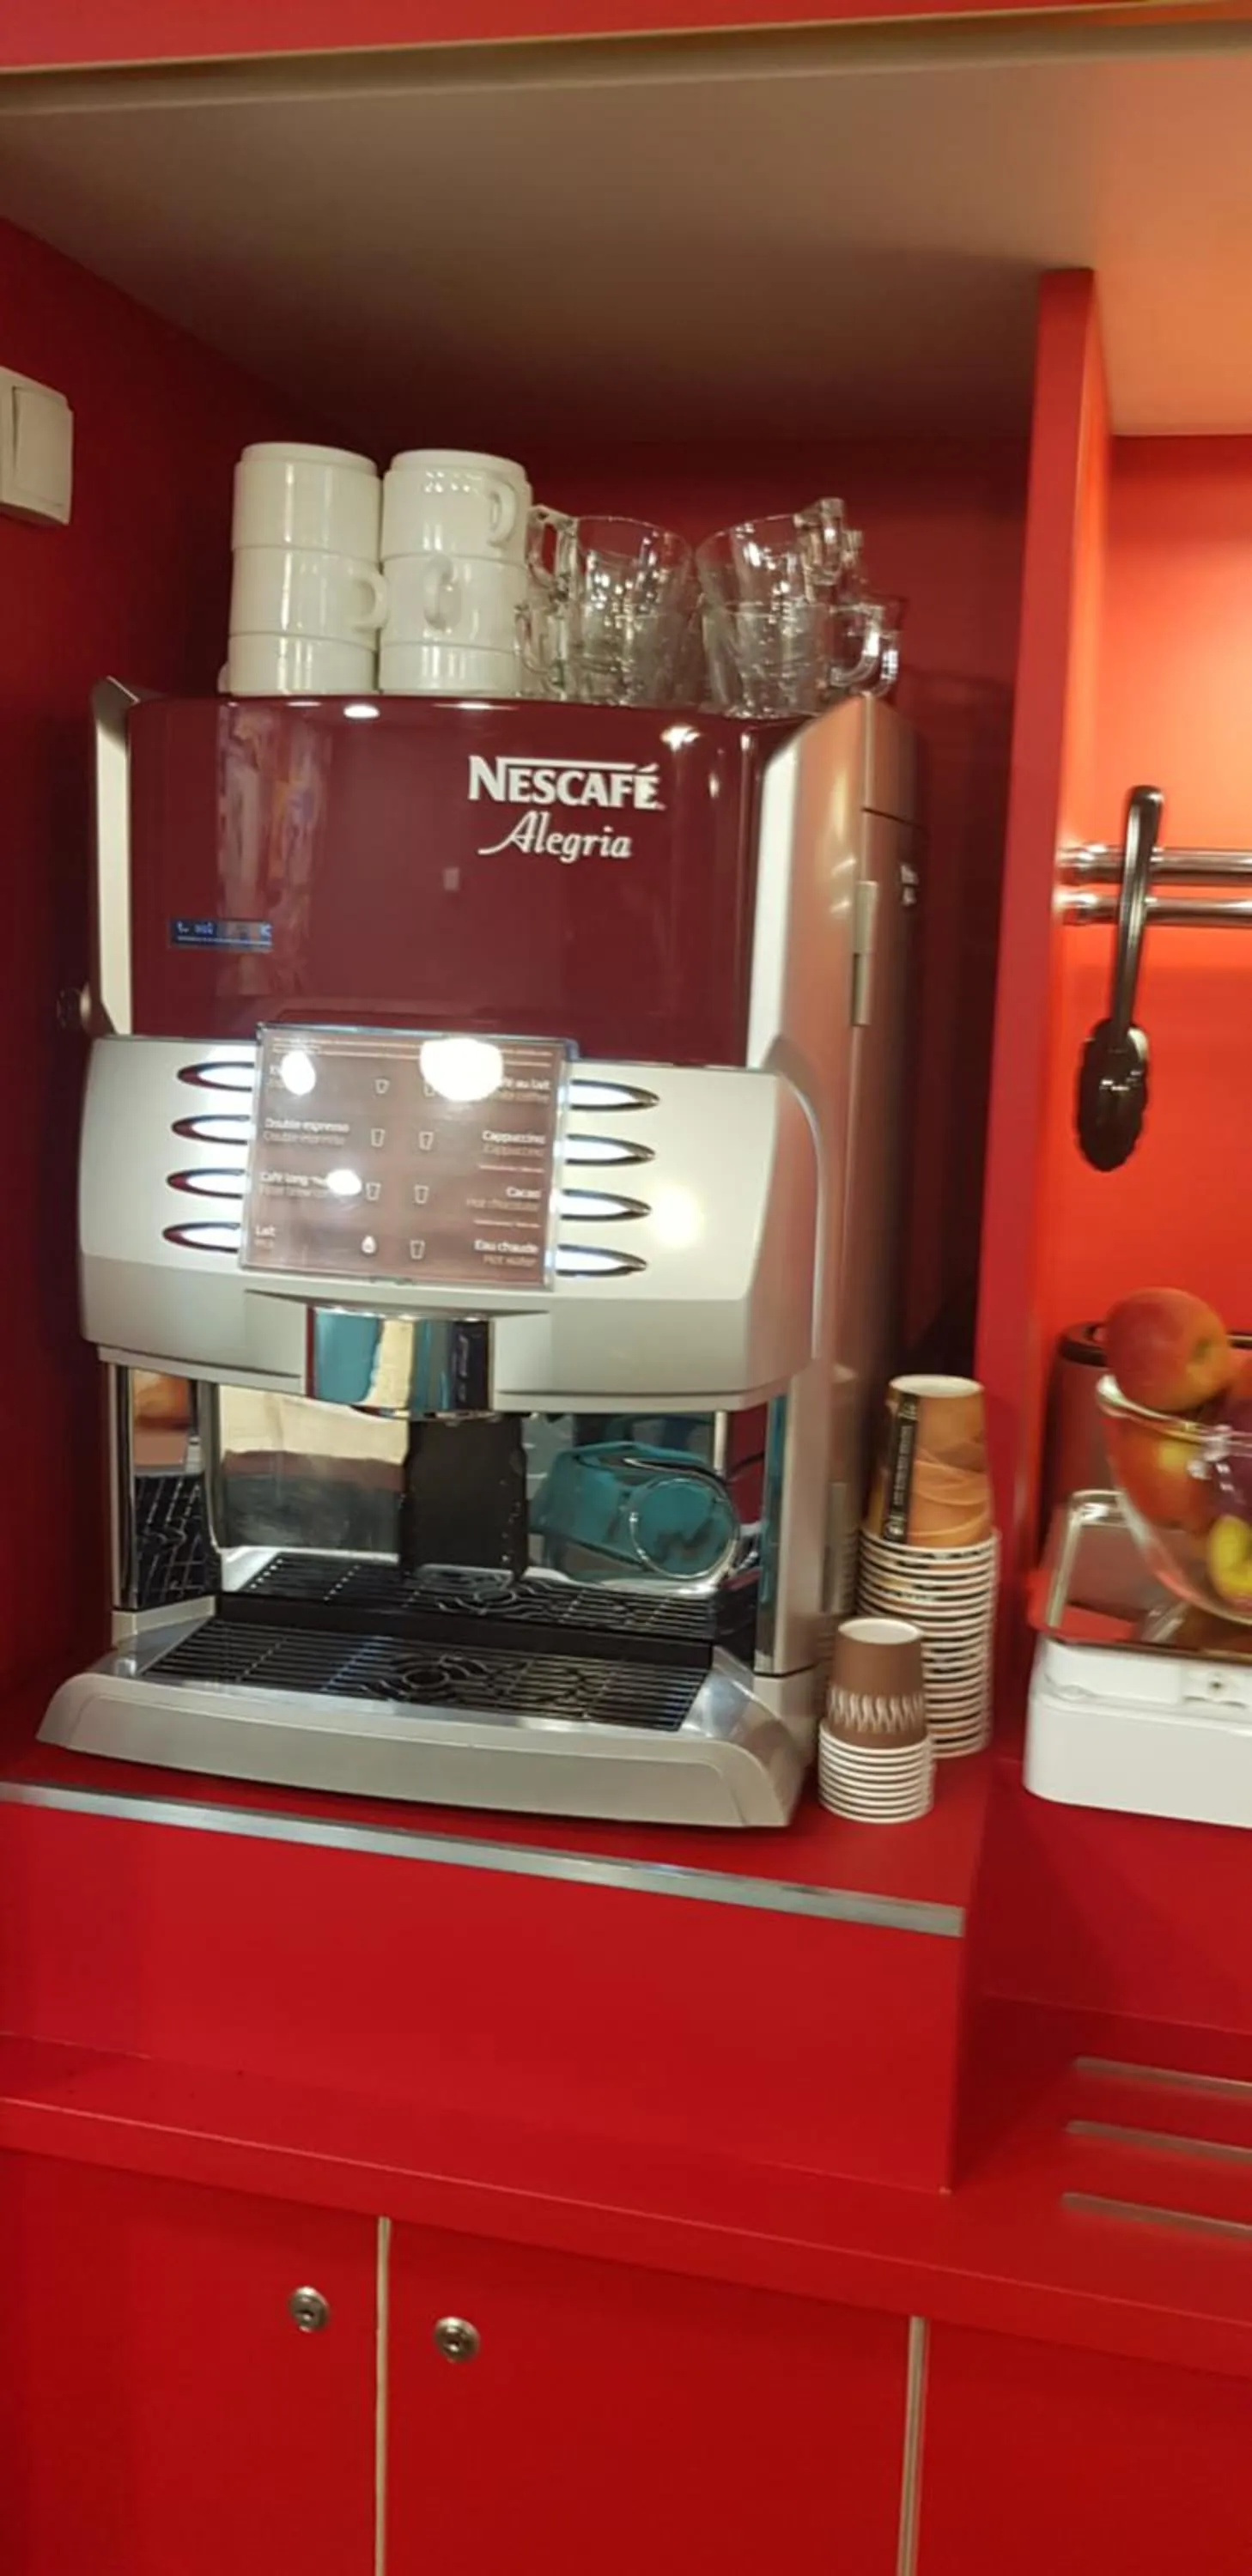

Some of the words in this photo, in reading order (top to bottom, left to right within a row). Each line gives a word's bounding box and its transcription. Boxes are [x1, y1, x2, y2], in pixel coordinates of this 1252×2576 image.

[468, 755, 661, 810] NESCAFÉ
[477, 811, 632, 864] Alegria
[482, 1130, 545, 1145] Cappuccino
[506, 1186, 542, 1199] Cacao
[255, 1225, 276, 1236] Lait
[474, 1239, 495, 1251] Eau
[497, 1241, 539, 1254] chaude
